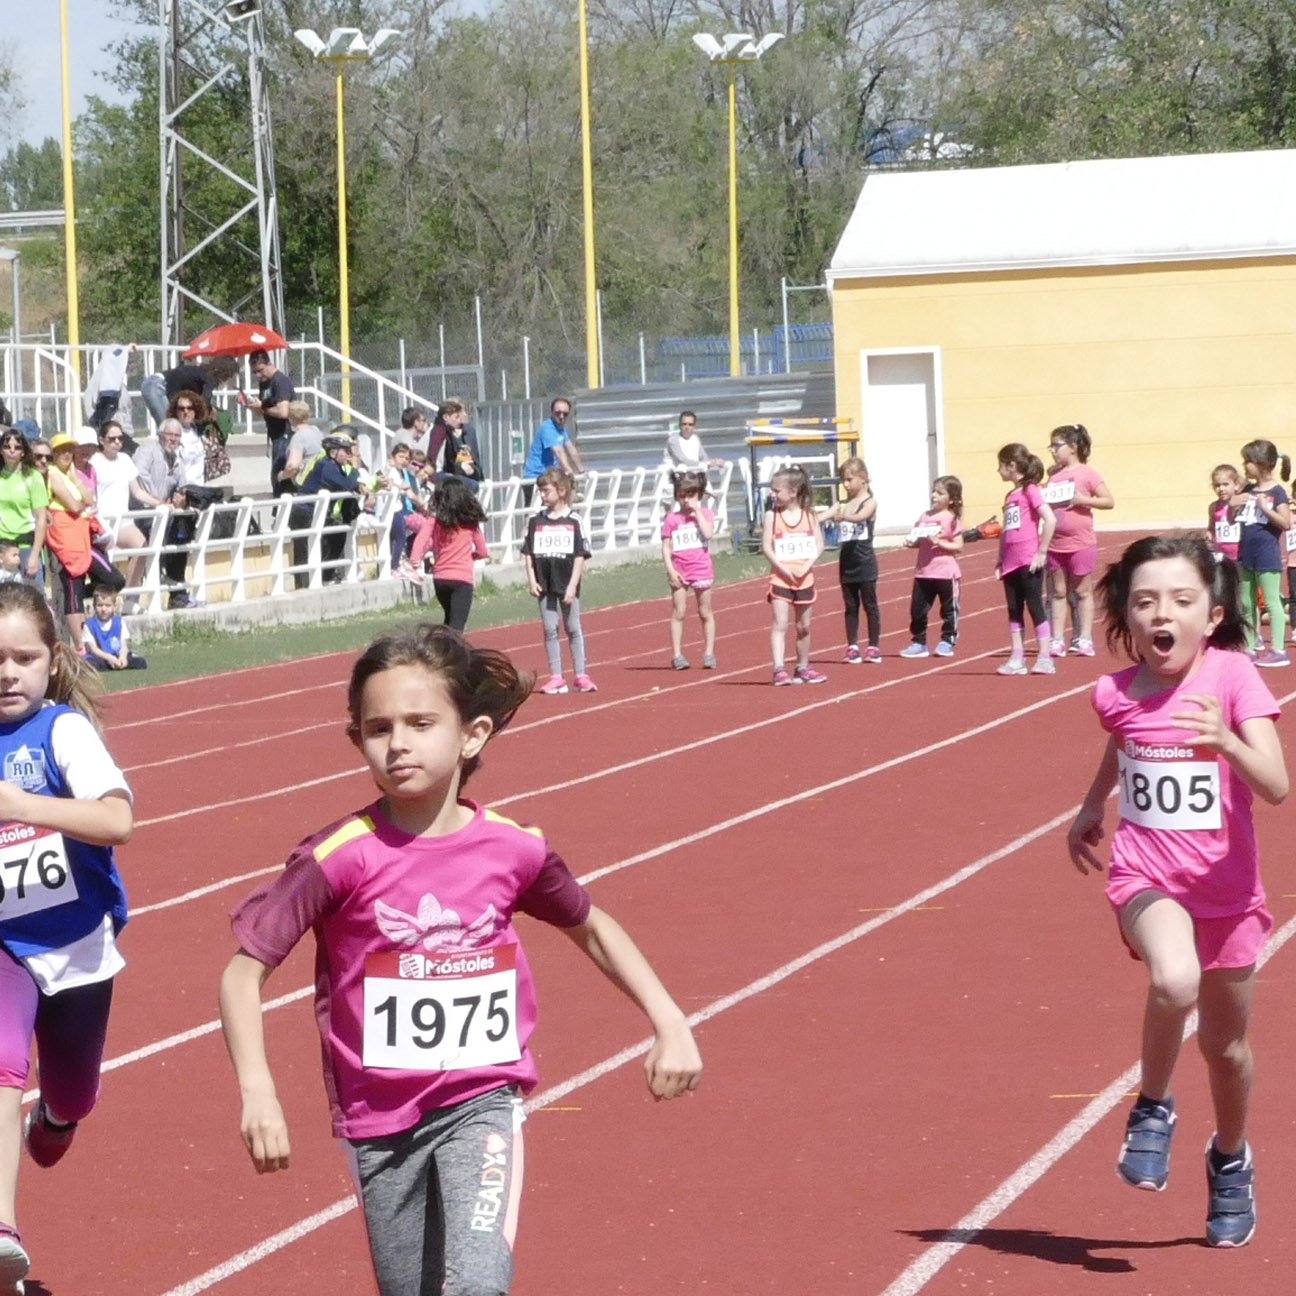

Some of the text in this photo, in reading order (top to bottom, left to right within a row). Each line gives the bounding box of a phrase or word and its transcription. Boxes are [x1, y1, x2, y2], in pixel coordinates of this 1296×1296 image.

[537, 534, 571, 548] 1989
[1119, 767, 1215, 815] 1805
[374, 989, 510, 1049] 1975
